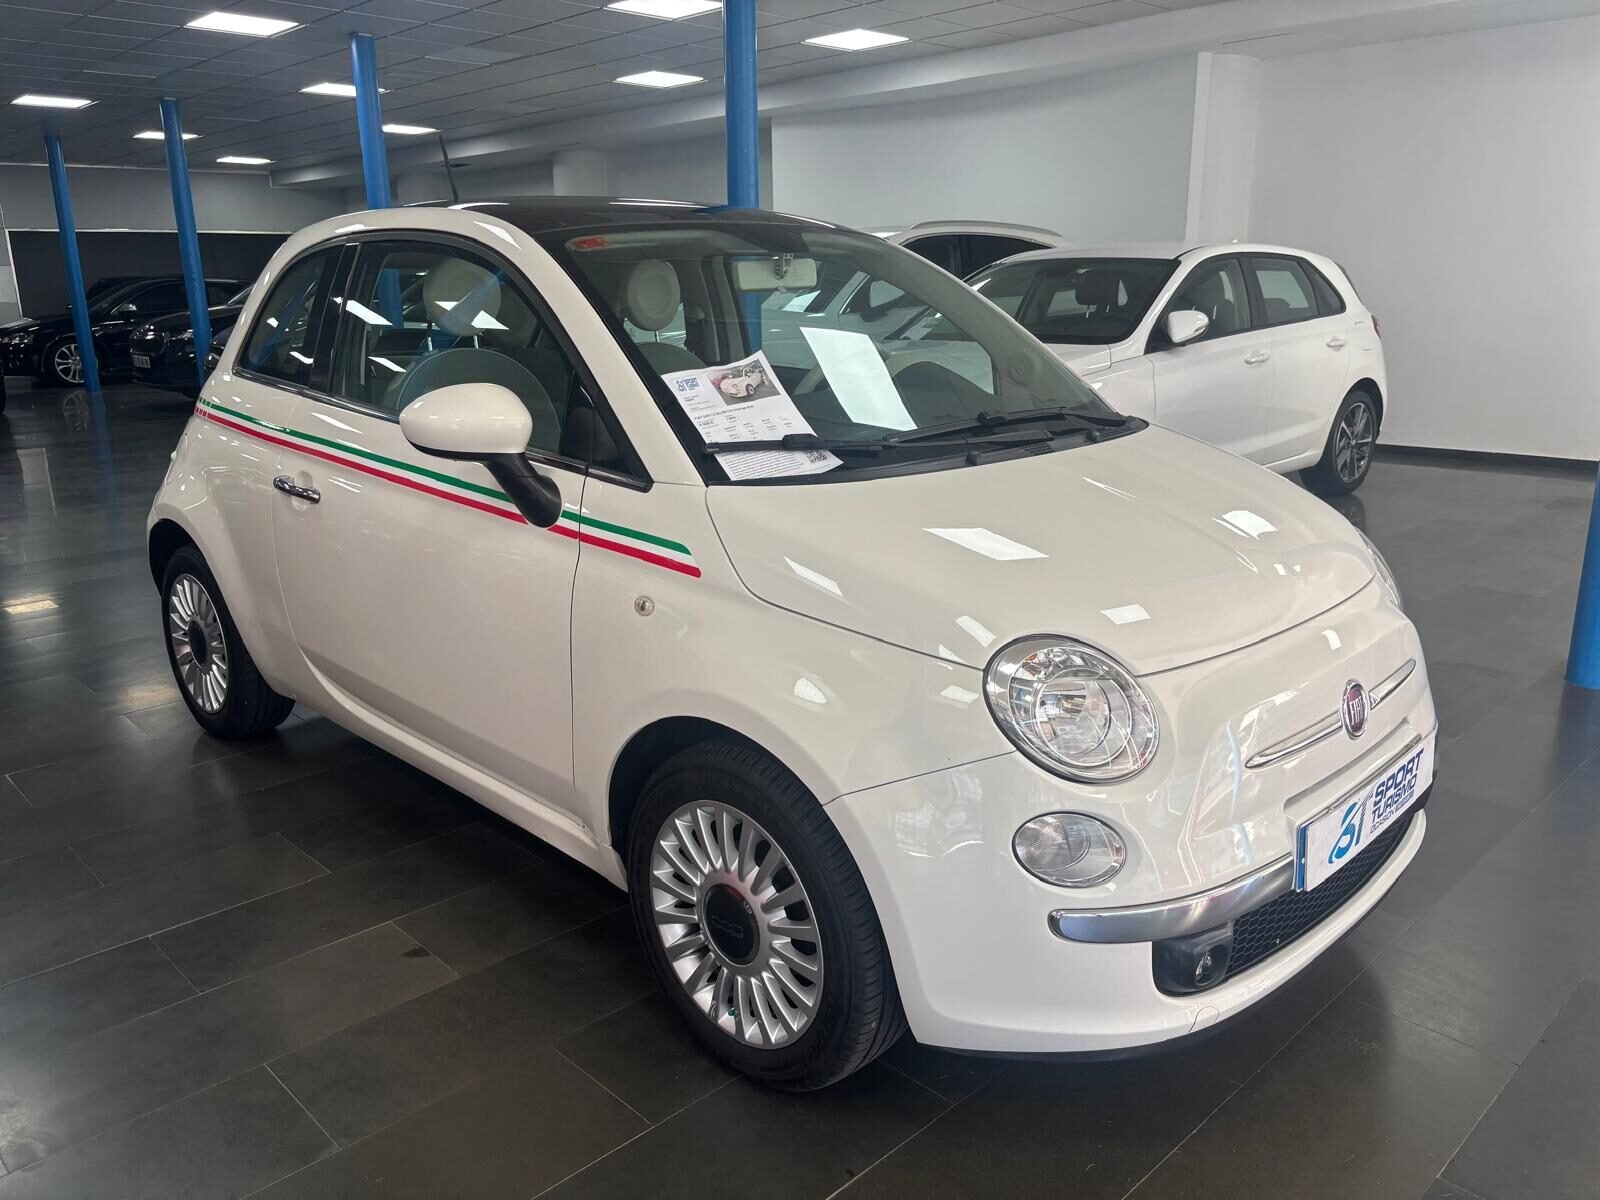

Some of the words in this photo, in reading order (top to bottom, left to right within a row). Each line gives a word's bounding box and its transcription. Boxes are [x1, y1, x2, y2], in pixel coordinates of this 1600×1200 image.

[1349, 696, 1364, 726] FIAT
[1371, 773, 1418, 824] TURISMO
[1373, 747, 1424, 808] SPORT
